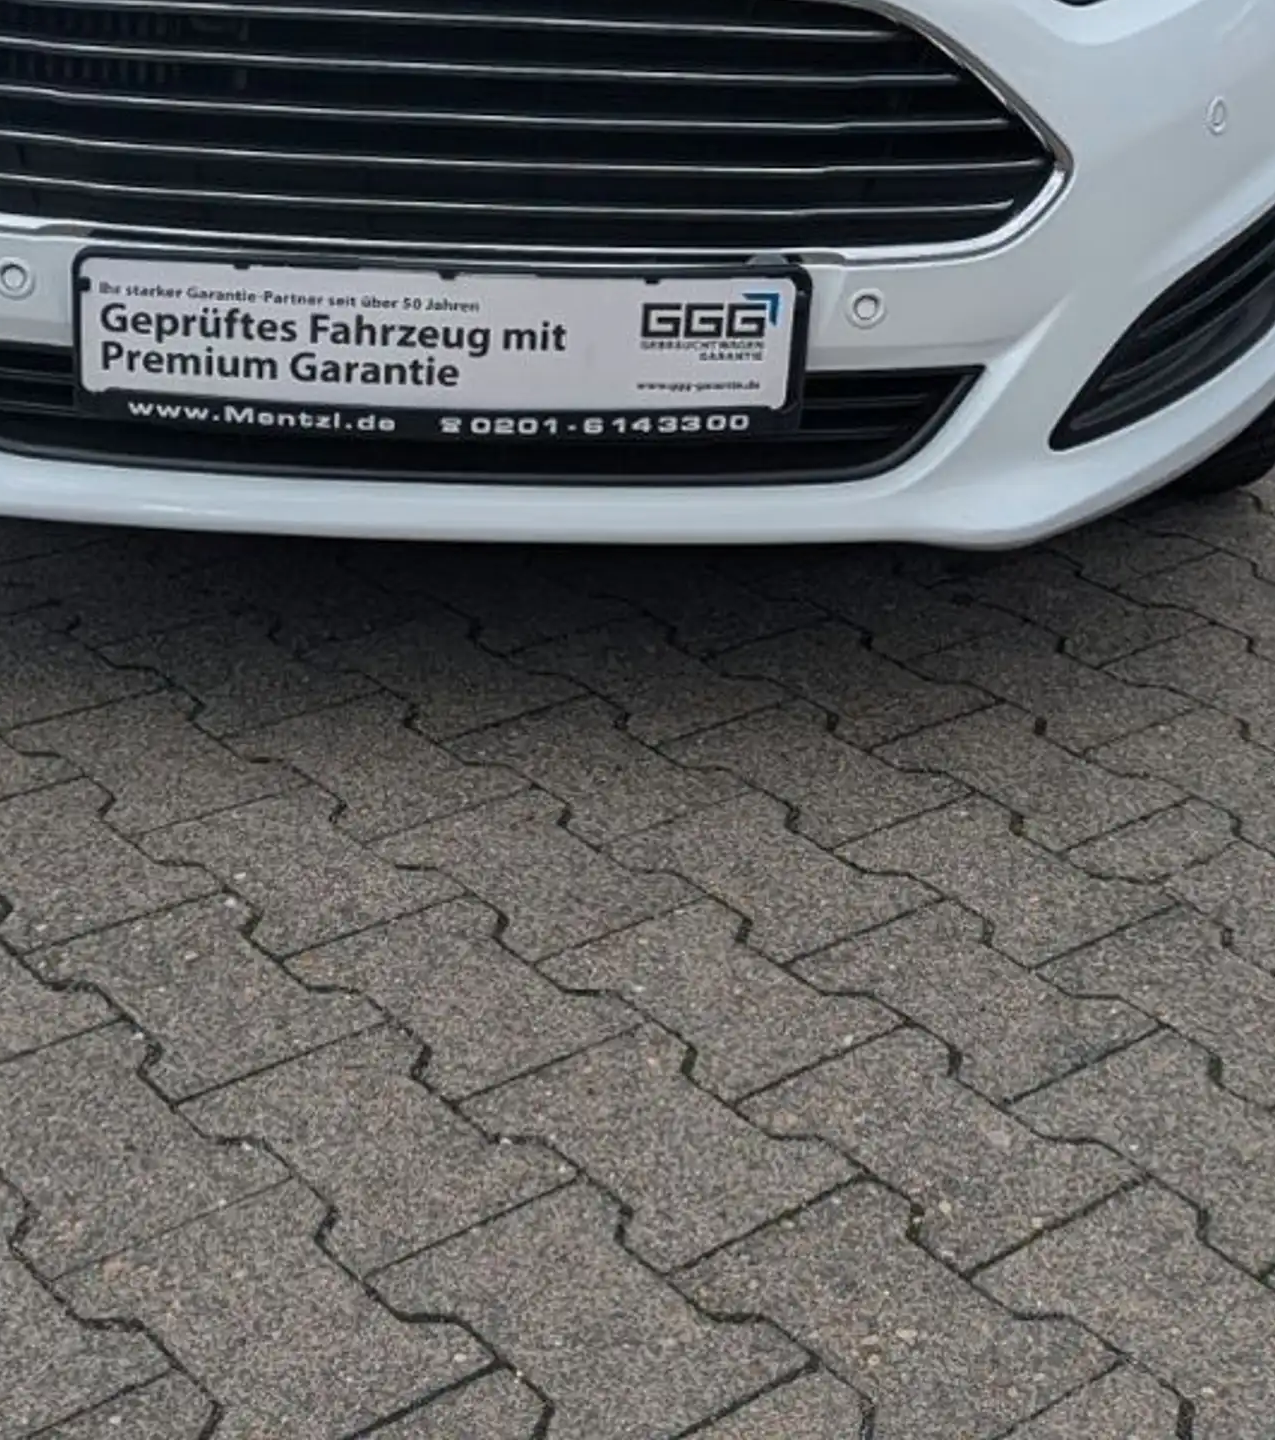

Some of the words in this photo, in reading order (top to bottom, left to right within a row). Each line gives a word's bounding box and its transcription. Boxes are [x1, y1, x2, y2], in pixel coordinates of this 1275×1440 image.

[98, 281, 121, 296] Ihr
[125, 284, 182, 299] starker
[186, 287, 323, 307] Garantie-Partner
[328, 294, 356, 309] seit
[360, 293, 397, 310] über
[402, 297, 422, 311] 50
[425, 297, 480, 313] Jahren
[100, 302, 298, 343] Geprüftes
[309, 312, 491, 358] Fahrzeug
[502, 319, 567, 353] mit
[641, 300, 770, 338] GGG
[100, 341, 278, 380] Premium
[288, 351, 460, 388] Garantie
[698, 351, 764, 362] GARANTIE
[636, 379, 760, 393] www.ggg-garantie.de
[128, 401, 396, 433] www.Mentzl.de
